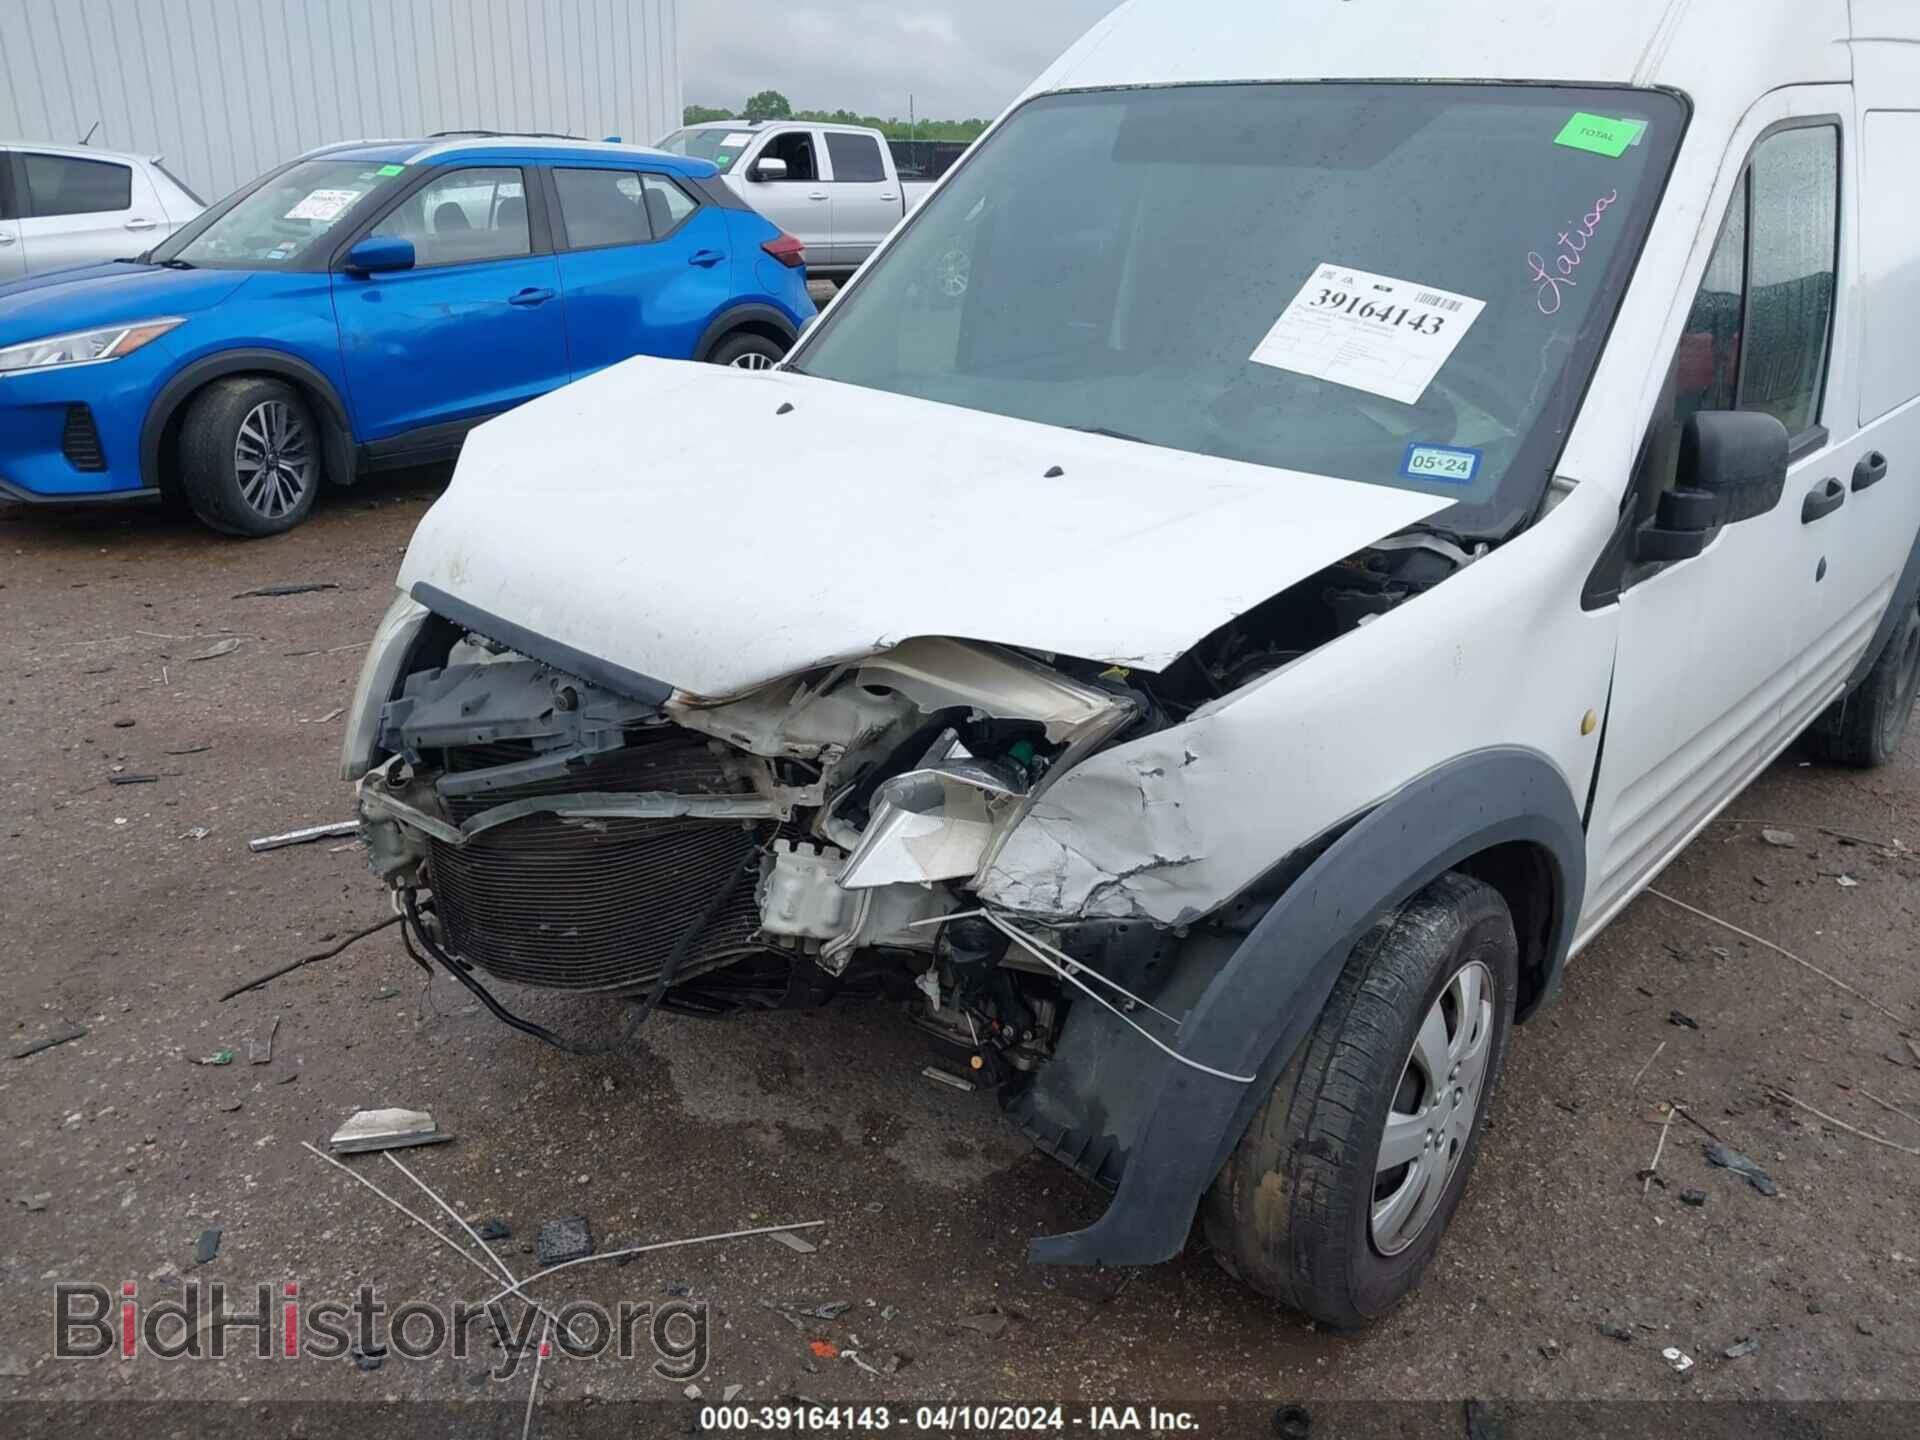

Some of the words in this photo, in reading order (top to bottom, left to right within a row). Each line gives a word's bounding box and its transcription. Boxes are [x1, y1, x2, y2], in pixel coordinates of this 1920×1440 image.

[1579, 126, 1615, 142] TOTAL
[1309, 288, 1446, 336] 39164143
[1412, 455, 1436, 470] 05
[1445, 458, 1469, 473] 24
